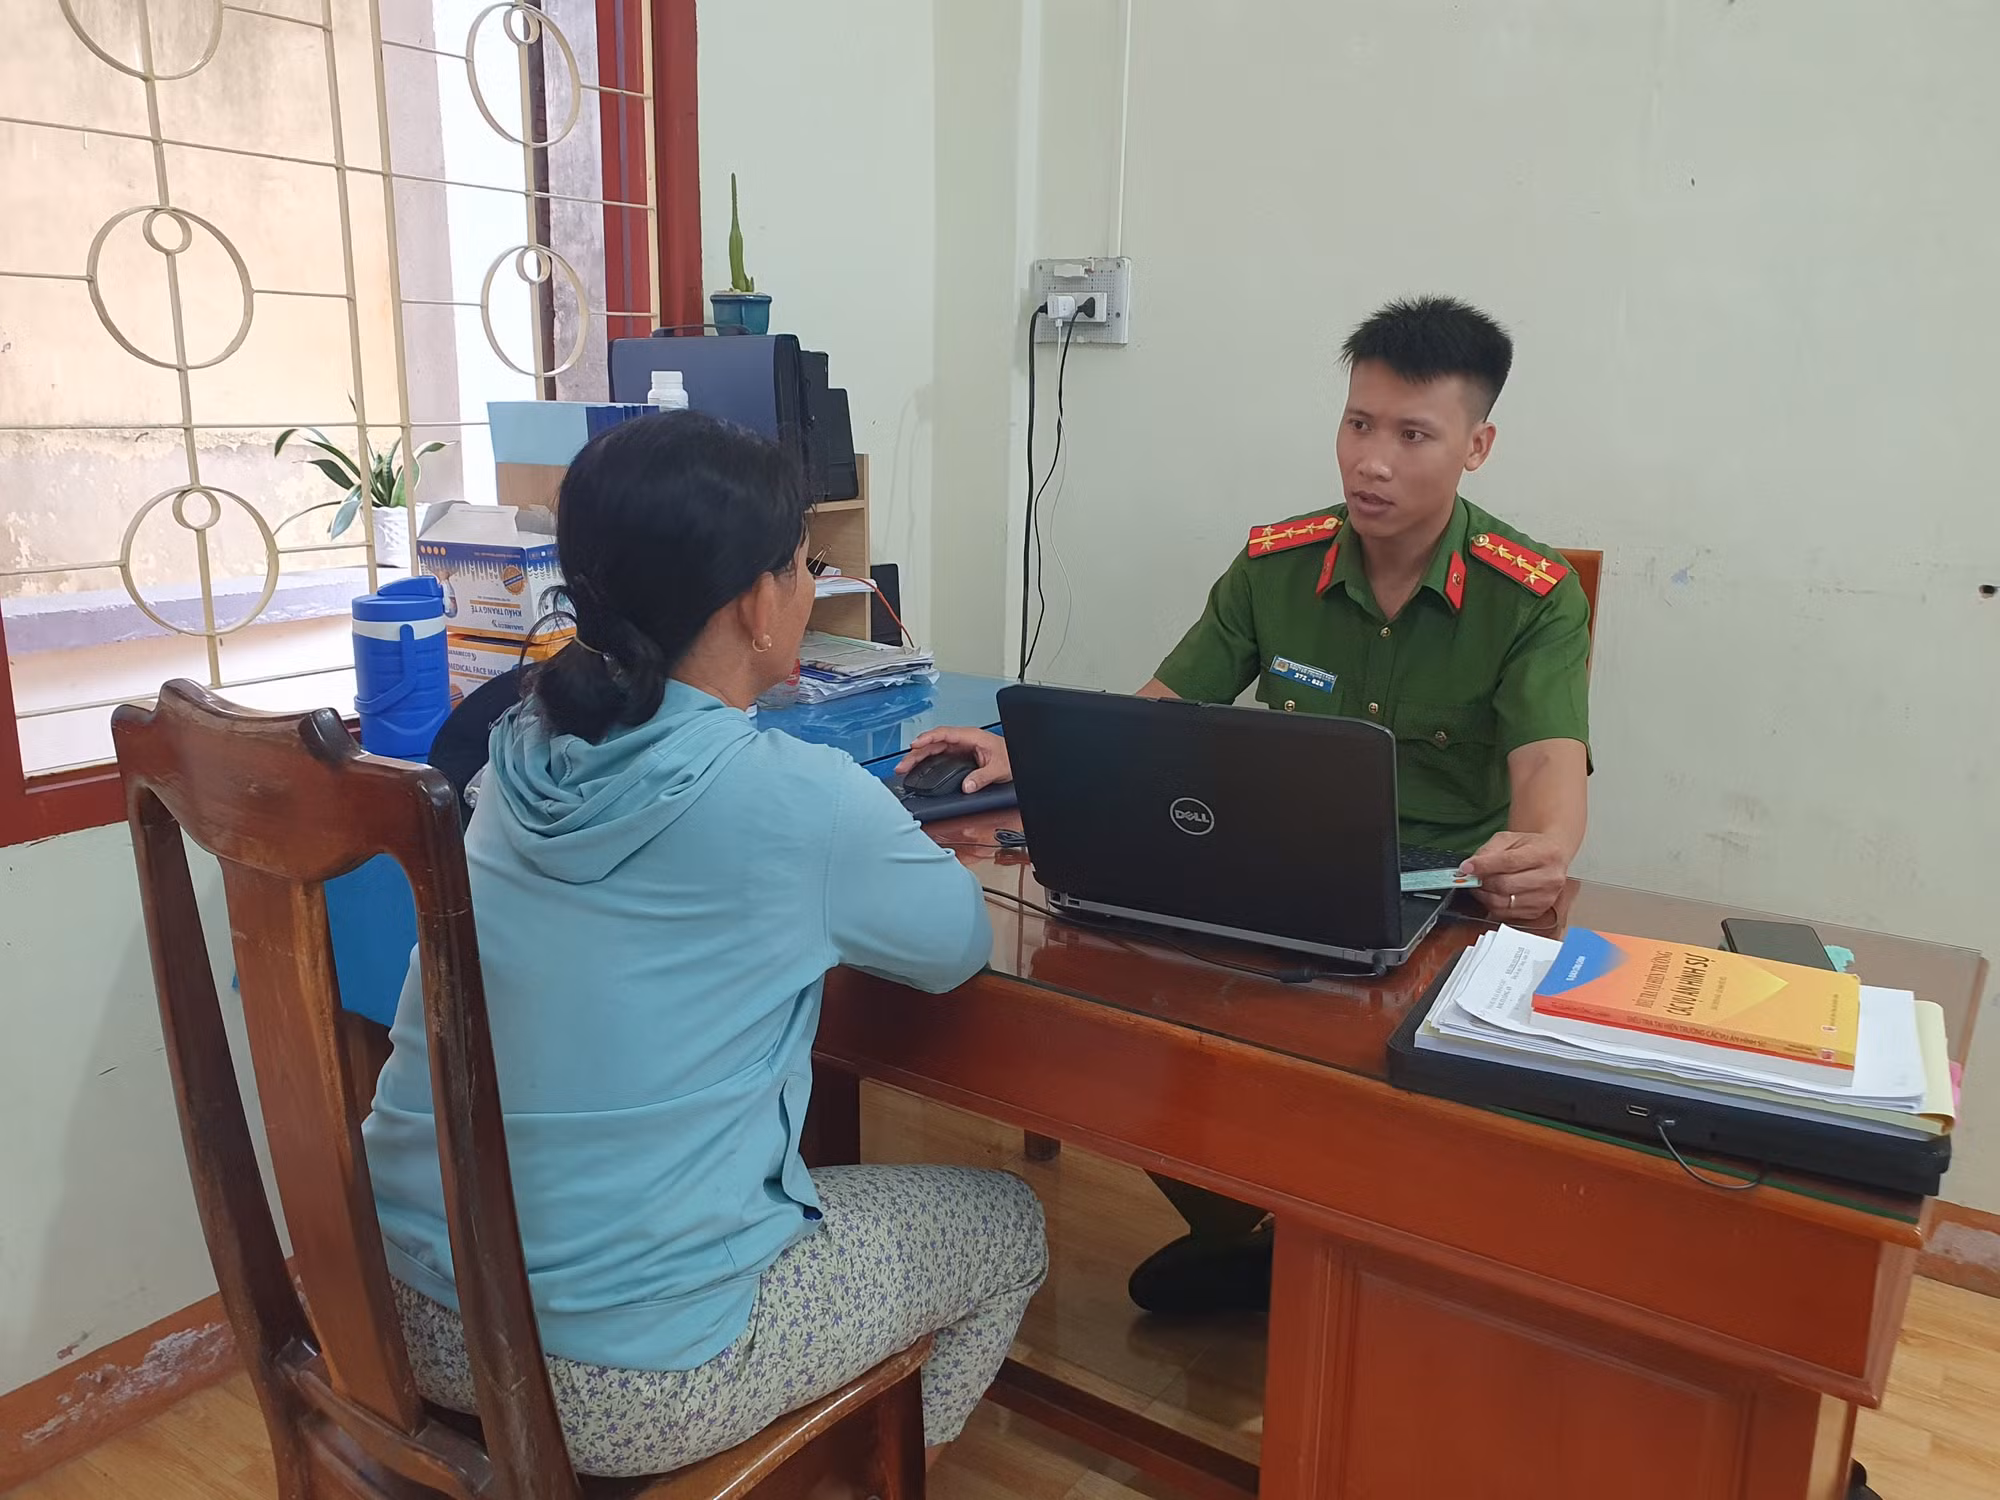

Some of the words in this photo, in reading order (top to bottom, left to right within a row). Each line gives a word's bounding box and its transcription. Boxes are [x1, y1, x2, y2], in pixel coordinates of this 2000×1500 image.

[473, 665, 487, 675] FACE
[1174, 809, 1210, 823] DELL
[1662, 1003, 1695, 1017] CÁC
[1684, 952, 1716, 968] SỰ
